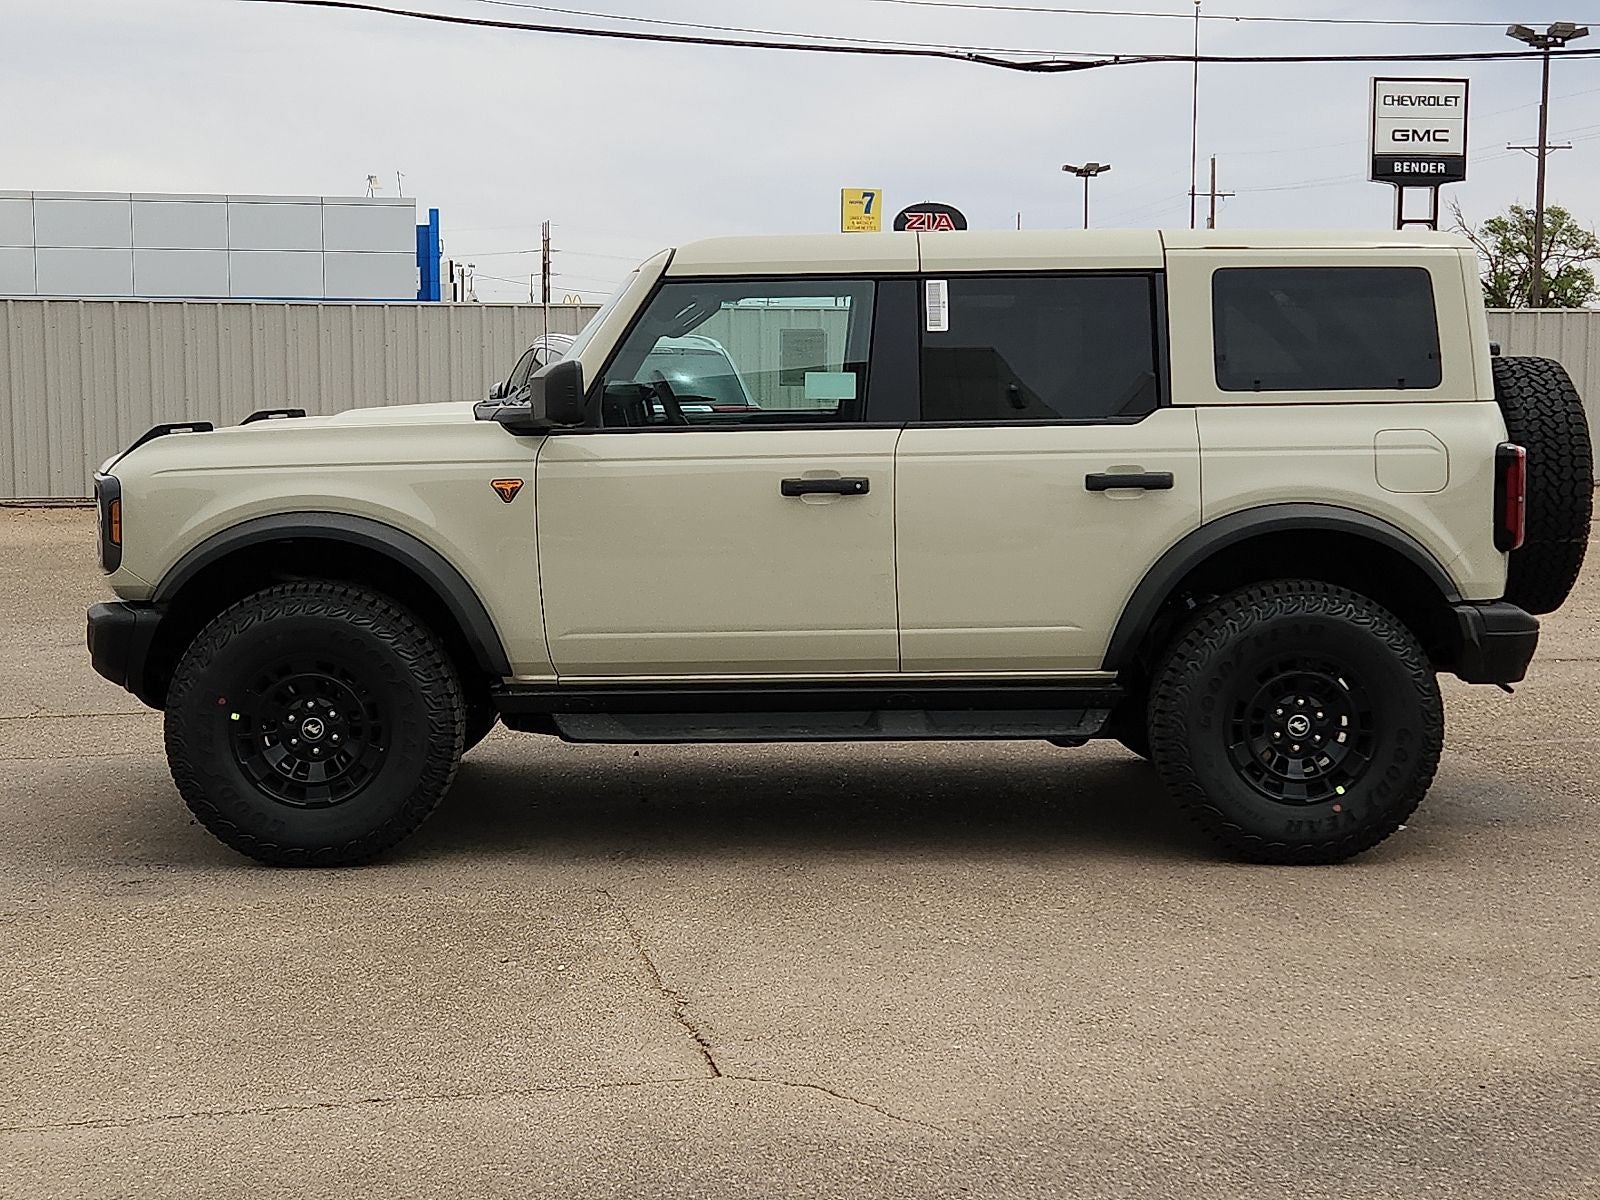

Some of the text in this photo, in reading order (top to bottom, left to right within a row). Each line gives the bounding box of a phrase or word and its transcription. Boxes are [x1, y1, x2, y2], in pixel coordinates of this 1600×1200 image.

[1383, 94, 1461, 107] CHEVROLET
[1391, 129, 1450, 143] GMC
[1393, 161, 1446, 174] BENDER
[861, 191, 876, 215] 7
[904, 211, 956, 232] ZIA
